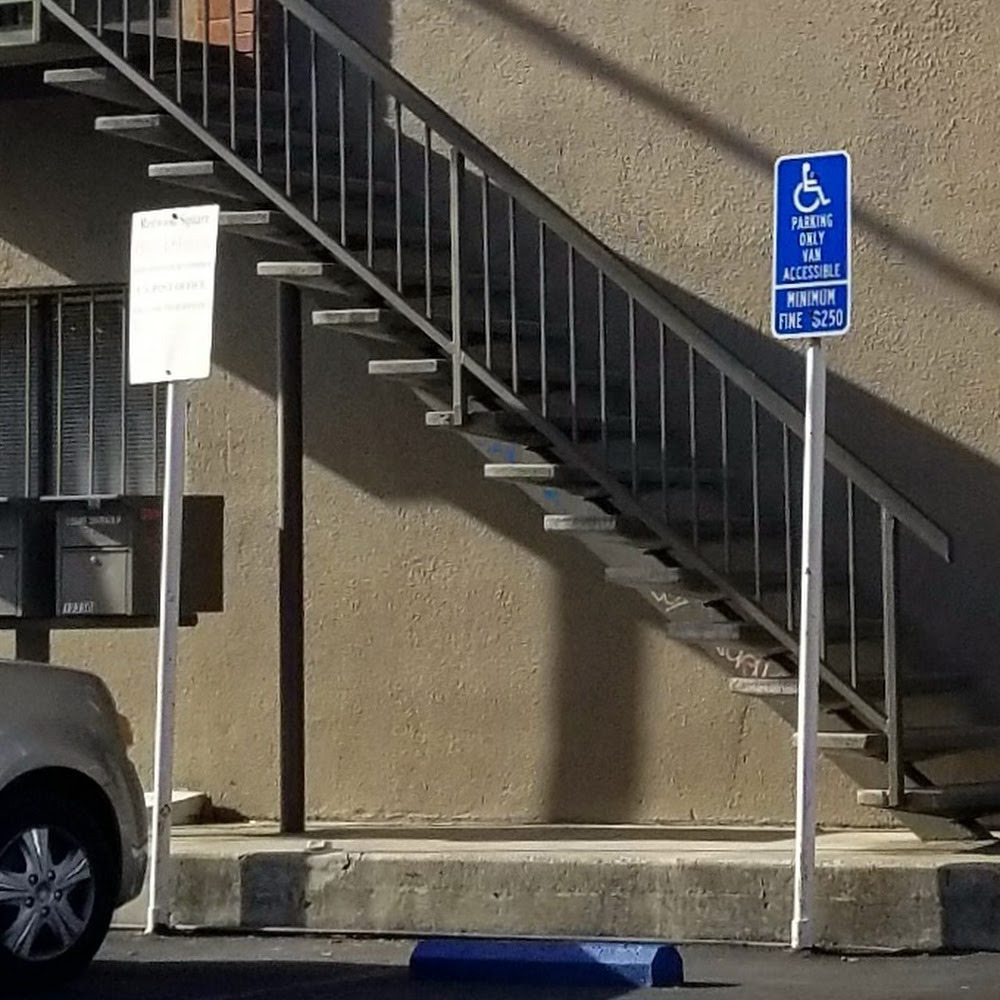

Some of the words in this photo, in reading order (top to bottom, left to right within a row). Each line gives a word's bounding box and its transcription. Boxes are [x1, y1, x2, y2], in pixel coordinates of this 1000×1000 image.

[791, 213, 833, 231] PARKING
[799, 230, 825, 247] ONLY
[802, 247, 822, 262] VAN
[782, 263, 841, 282] ACCESSIBLE
[786, 288, 836, 308] MINIMUM
[779, 312, 803, 330] FINE
[811, 309, 843, 329] $250
